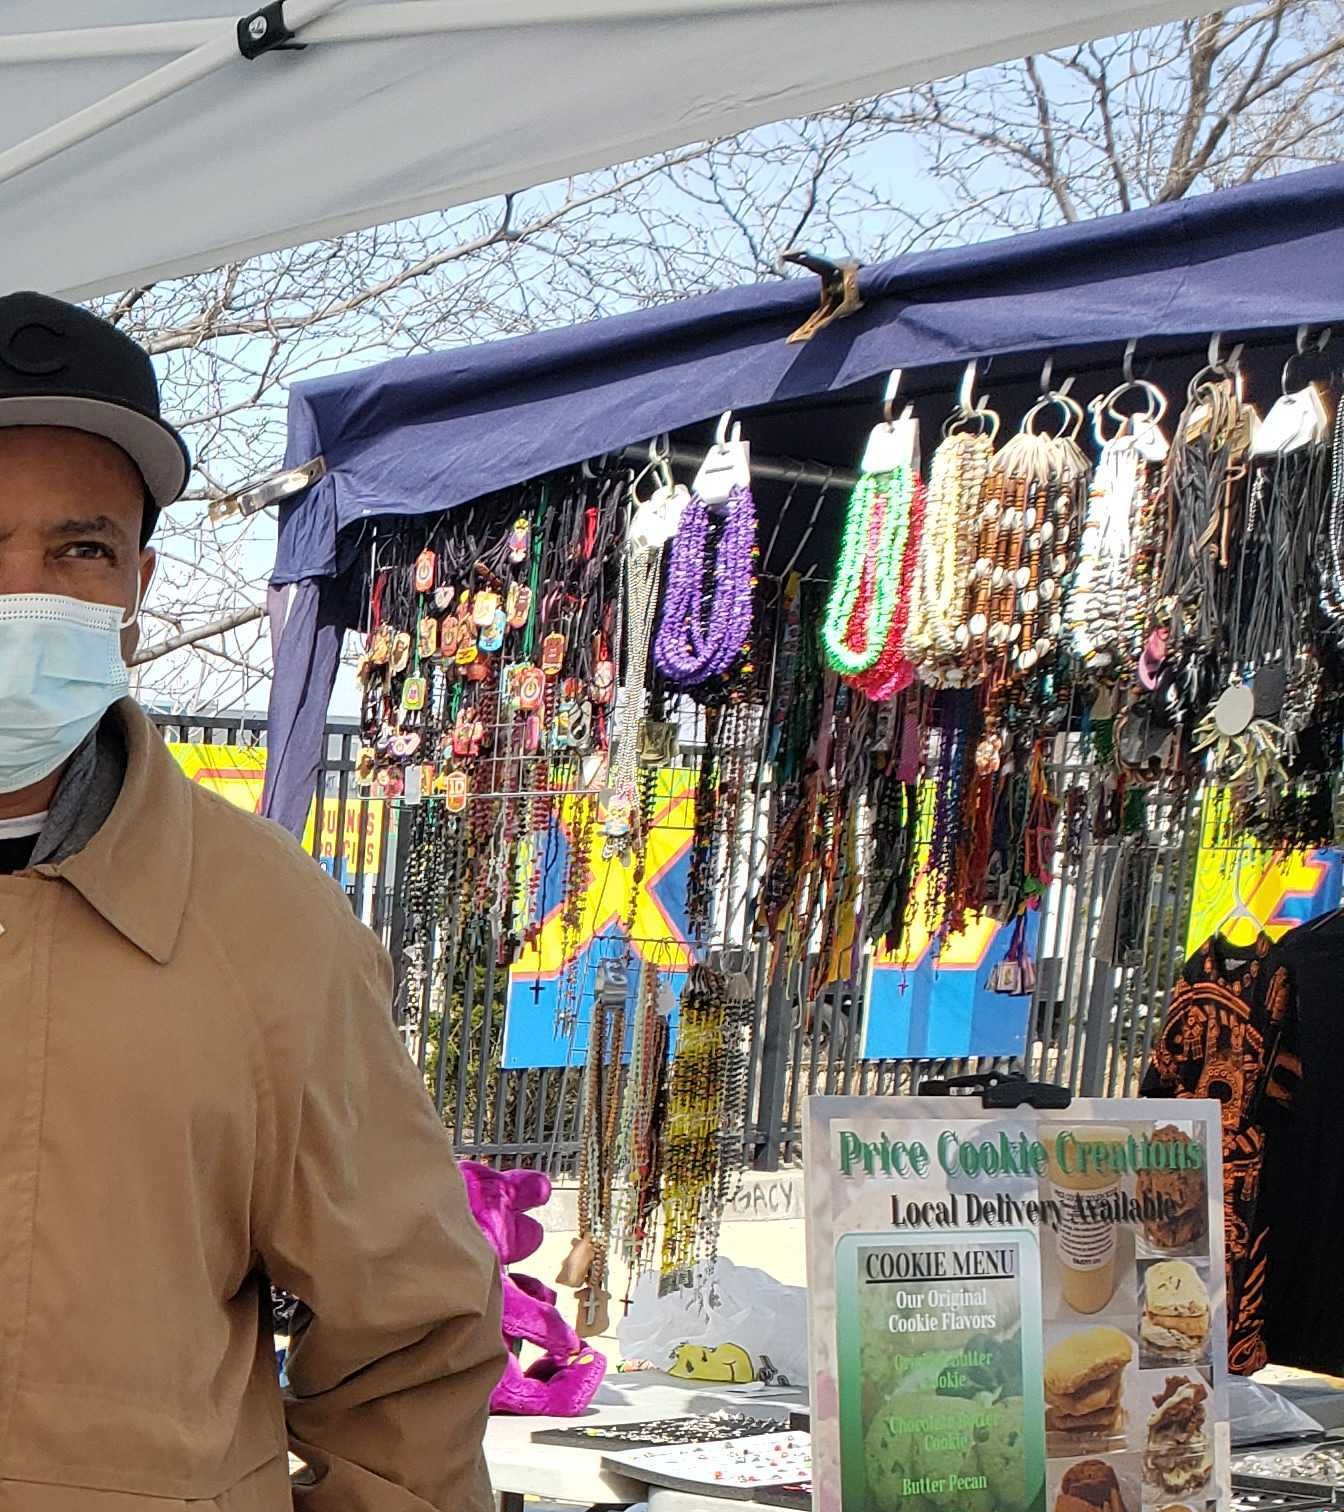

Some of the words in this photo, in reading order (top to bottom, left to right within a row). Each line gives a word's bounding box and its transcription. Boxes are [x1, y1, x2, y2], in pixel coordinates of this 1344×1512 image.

[0, 322, 69, 376] C
[839, 1131, 929, 1177] Price
[937, 1130, 1048, 1177] Cookie
[1056, 1130, 1203, 1174] Creations
[890, 1194, 958, 1227] Local
[965, 1193, 1061, 1232] Delivery
[1071, 1191, 1177, 1224] Available
[866, 1250, 945, 1278] COOKIE
[950, 1249, 1015, 1277] MENU
[895, 1291, 925, 1309] Our
[928, 1288, 987, 1310] Original
[888, 1314, 939, 1334] Cookie
[941, 1313, 996, 1332] Flavors
[902, 1476, 945, 1496] Butter
[948, 1473, 987, 1493] Pecan
